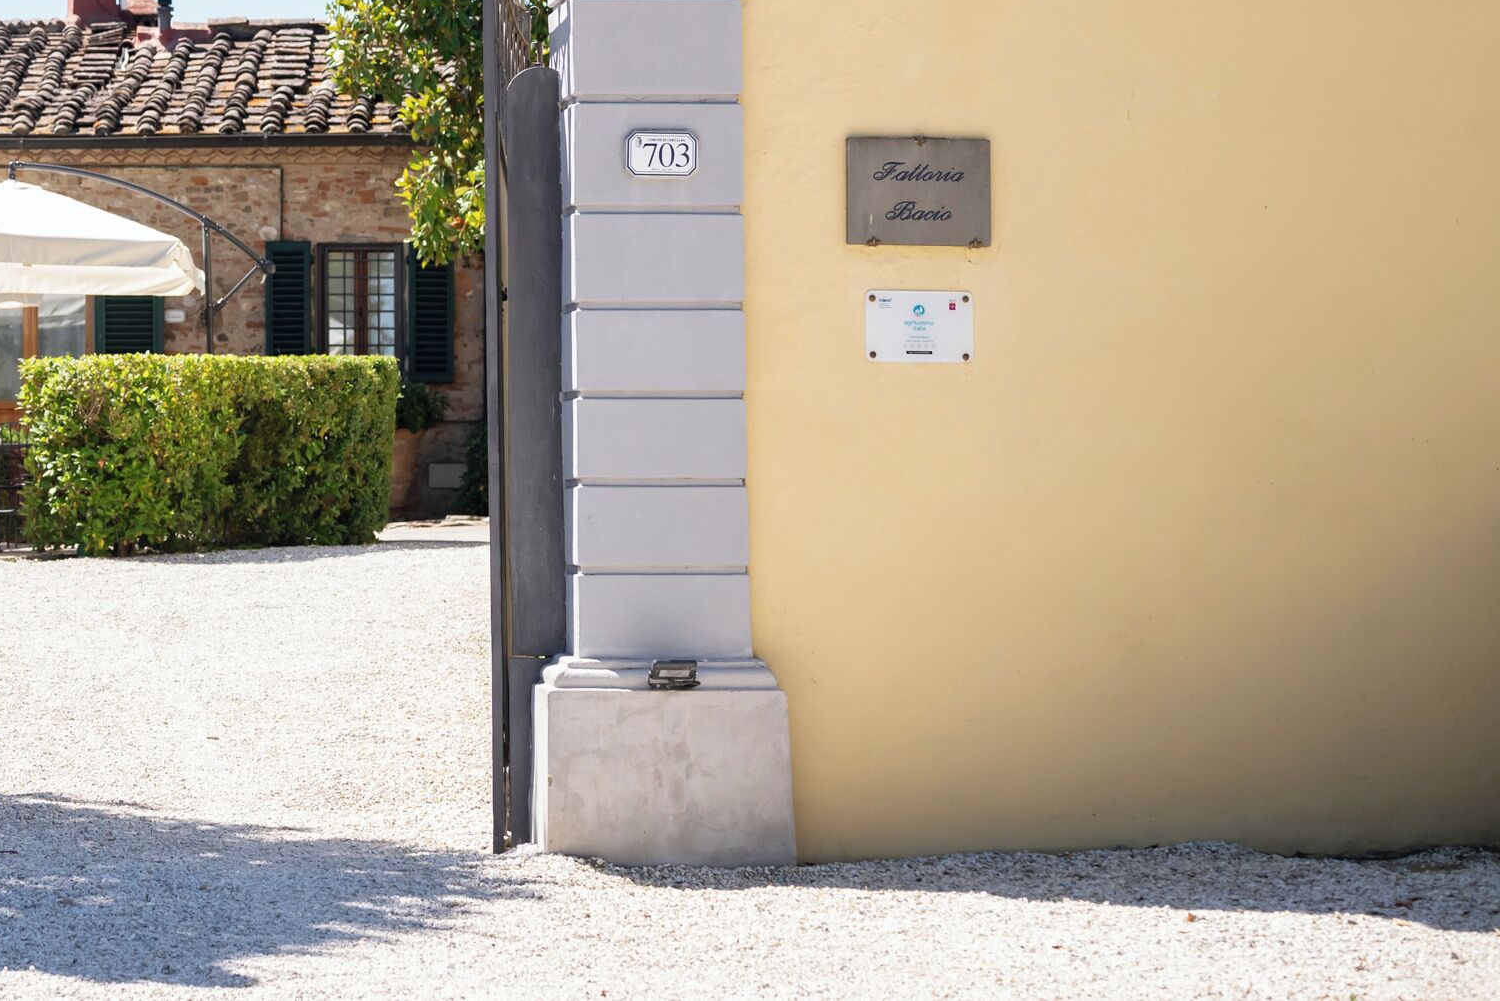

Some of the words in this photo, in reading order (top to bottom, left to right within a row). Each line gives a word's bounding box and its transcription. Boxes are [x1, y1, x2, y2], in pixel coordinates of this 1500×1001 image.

[642, 142, 690, 167] 703
[873, 161, 965, 182] Fattoria
[885, 201, 955, 221] Bacio
